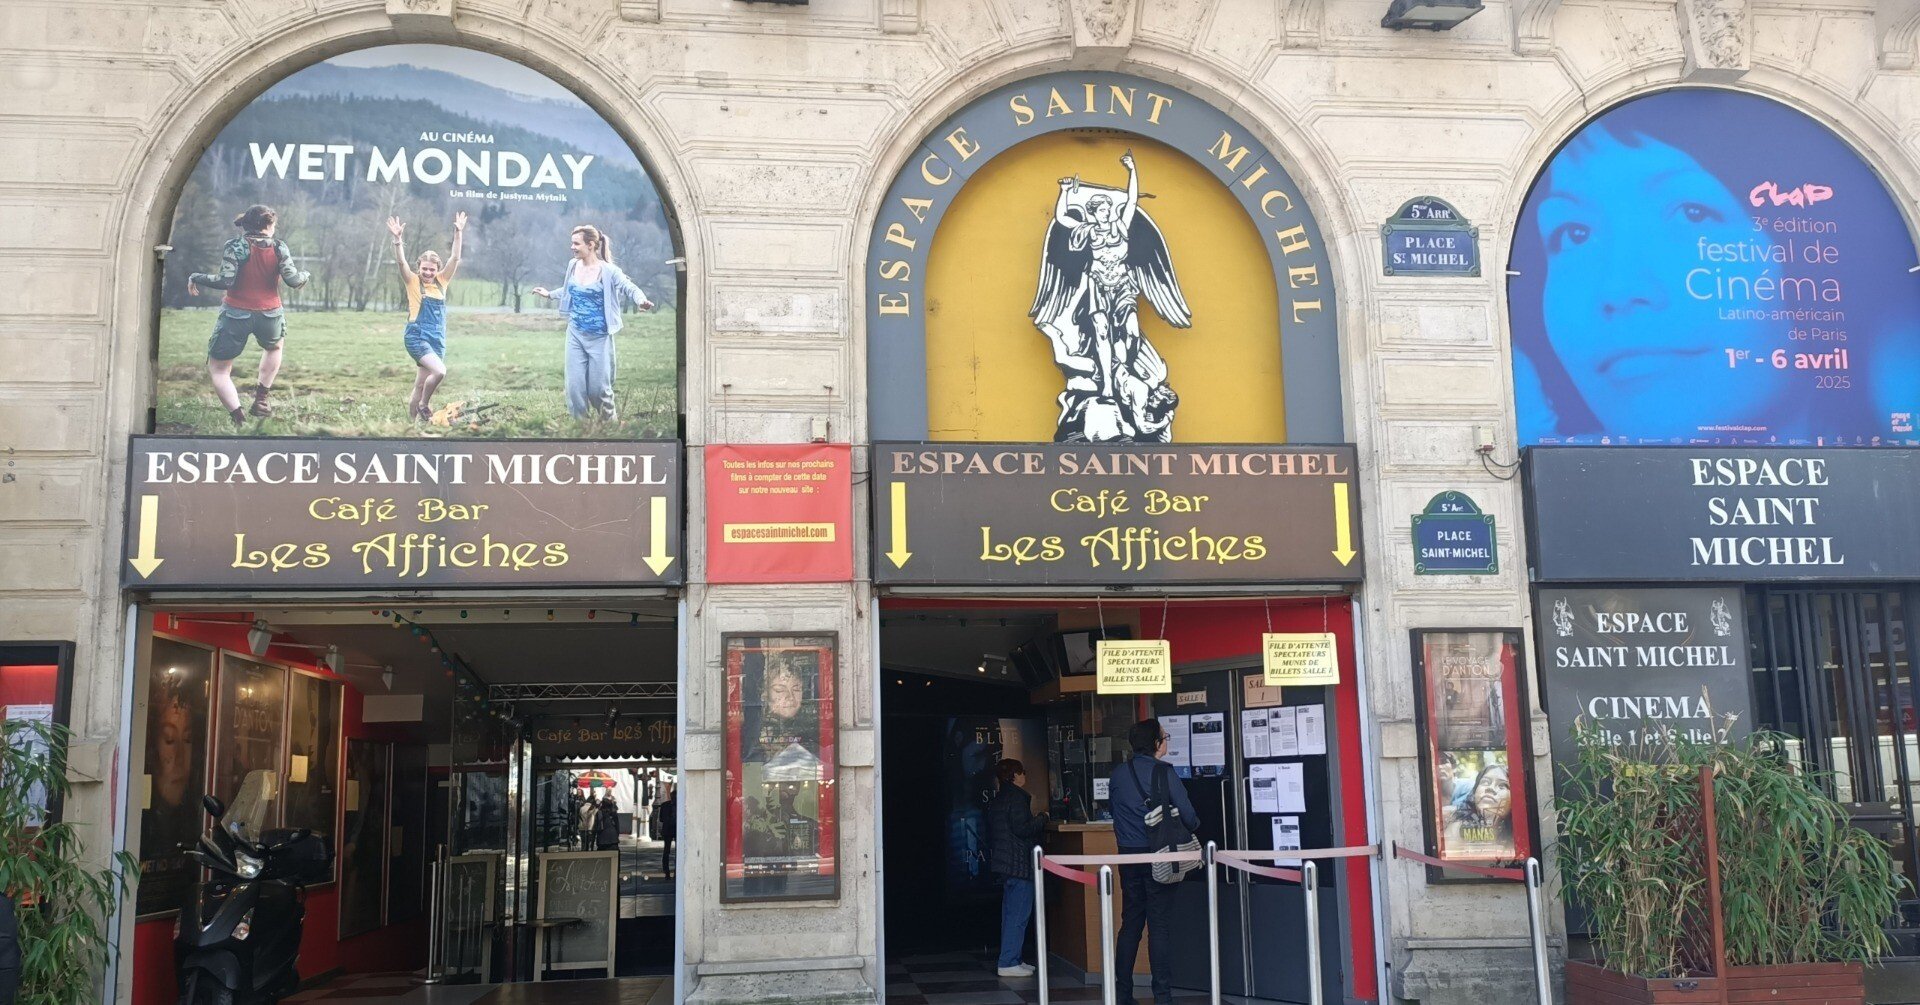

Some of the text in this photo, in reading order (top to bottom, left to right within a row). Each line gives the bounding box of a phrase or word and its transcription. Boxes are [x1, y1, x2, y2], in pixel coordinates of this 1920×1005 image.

[419, 130, 495, 144] AU CINÉMA
[249, 142, 594, 190] WET MONDAY
[450, 190, 568, 202] Un film de Justyna Mytnik
[878, 83, 1322, 325] ESPACE SAINT MICHEL
[1752, 215, 1837, 233] 3e édition
[1404, 236, 1456, 249] PLACE
[1697, 237, 1840, 264] festival de
[1410, 253, 1469, 266] MICHEL
[1685, 267, 1841, 302] Cinéma
[1718, 306, 1845, 322] Latino-américain
[1788, 327, 1847, 341] de Paris
[1725, 348, 1750, 368] 1er
[1771, 349, 1787, 369] 6
[1794, 348, 1849, 370] avril
[1815, 375, 1850, 389] 2025
[1697, 425, 1767, 433] www.festivalclap.com
[145, 452, 668, 485] ESPACE SAINT MICHEL
[723, 460, 835, 470] Toutes les infos sur nos prochains
[890, 451, 1349, 476] ESPACE SAINT MICHEL
[730, 472, 747, 481] films
[753, 473, 782, 483] compter
[783, 472, 792, 481] de
[793, 472, 811, 481] cette
[811, 472, 827, 481] date
[1690, 458, 1829, 486] ESPACE
[751, 486, 768, 494] notre
[769, 486, 798, 494] nouveau
[801, 485, 814, 494] site
[1050, 488, 1209, 519] Café Bar
[308, 497, 489, 526] Café Bar
[1708, 497, 1820, 526] SAINT
[731, 526, 828, 540] espacesaintmichel.com
[1437, 530, 1472, 541] PLACE
[231, 532, 569, 578] Les Affiches
[980, 526, 1267, 571] Les Affiches
[1421, 547, 1490, 558] SAINT-MICHEL
[1689, 536, 1845, 566] MICHEL
[1595, 612, 1689, 633] ESPACE
[1103, 649, 1164, 657] FILE D'ATTENTE
[1269, 642, 1330, 650] FILE D'ATTENTE
[1107, 658, 1160, 666] SPECTATEURS
[1281, 659, 1307, 667] MUNIS
[1452, 656, 1489, 665] VOYAGE
[1556, 645, 1736, 668] SAINT MICHEL
[1115, 666, 1152, 674] MUNIS DE
[1442, 665, 1490, 676] D'ANTON
[1103, 675, 1134, 683] BILLETS
[1248, 680, 1265, 689] SAL
[1588, 696, 1713, 720] CINEMA
[537, 728, 572, 744] Café
[578, 728, 607, 742] Bar
[613, 721, 643, 743] Les
[976, 731, 1019, 745] BLUE
[1628, 729, 1638, 746] 1
[1644, 729, 1662, 746] et
[1717, 728, 1729, 745] 2
[1463, 828, 1496, 841] MANAS
